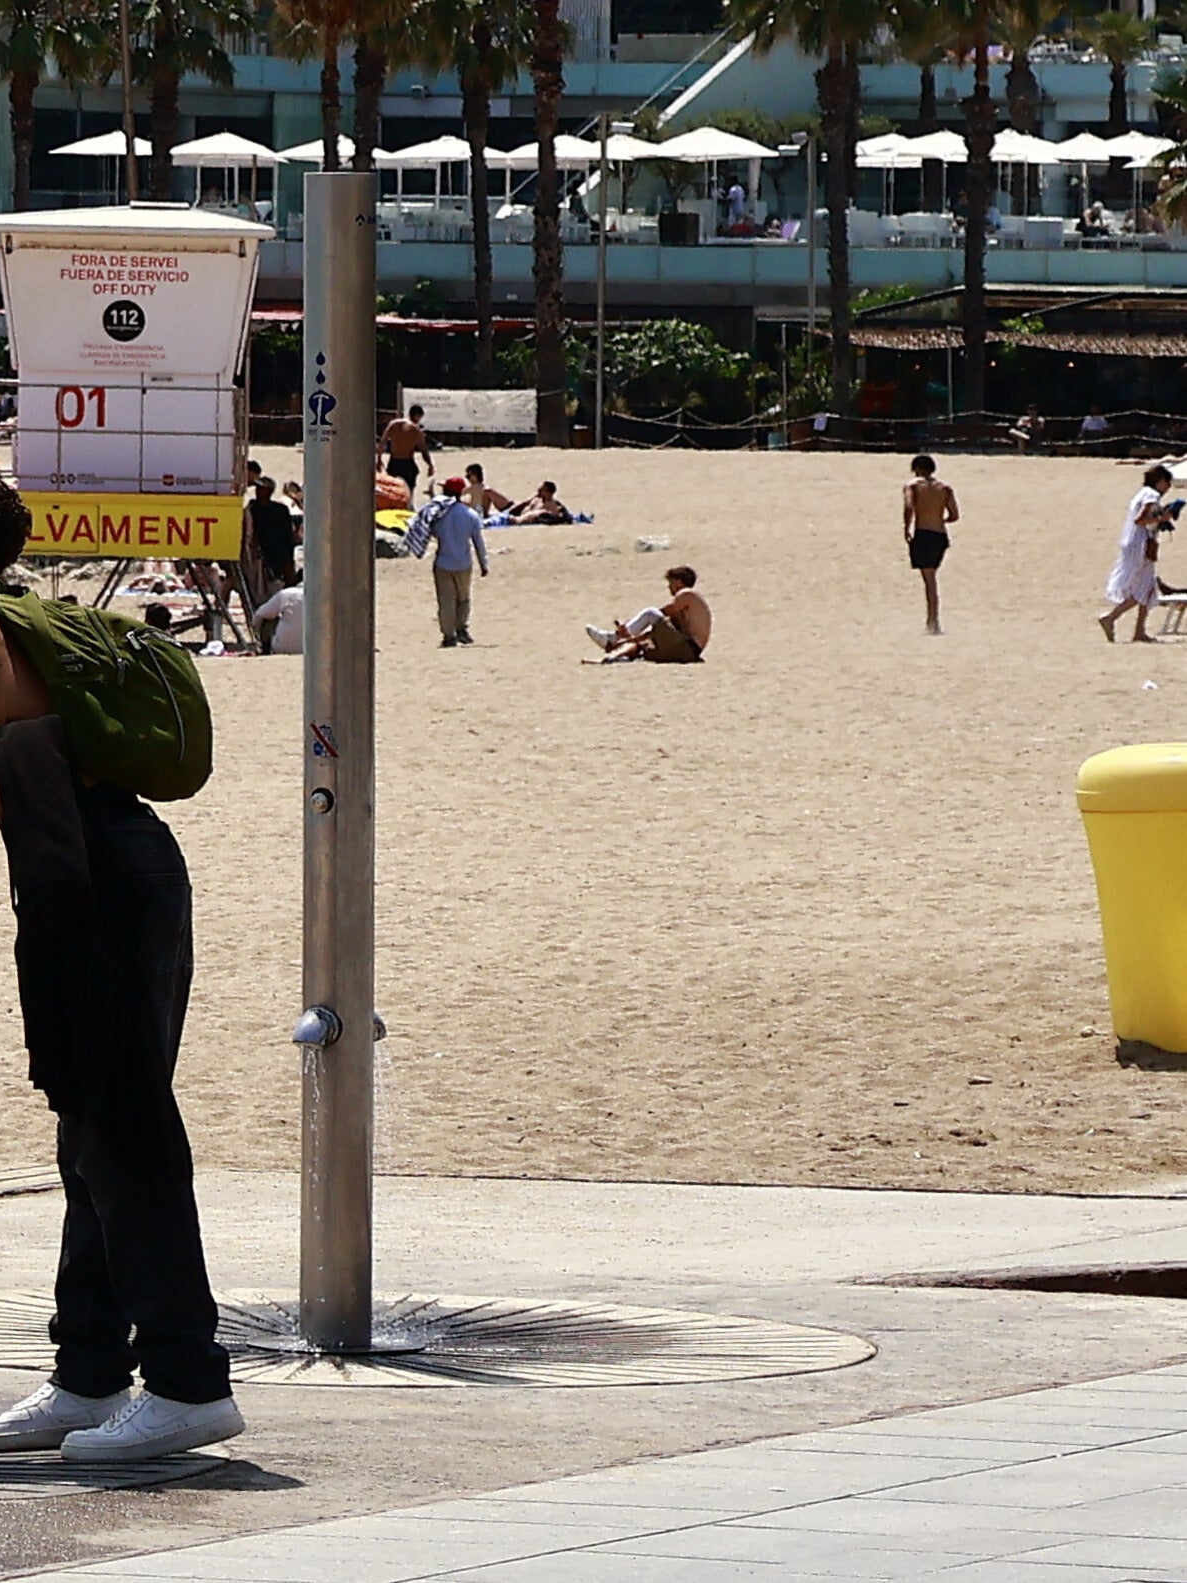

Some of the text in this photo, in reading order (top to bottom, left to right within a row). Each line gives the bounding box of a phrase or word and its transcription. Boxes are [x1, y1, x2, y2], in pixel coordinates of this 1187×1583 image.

[71, 254, 179, 268] FORA DE SERVEI
[60, 268, 189, 282] FUERA DE SERVICIO
[93, 283, 156, 296] OFF DUTY
[110, 309, 139, 325] 112
[55, 384, 105, 428] 01
